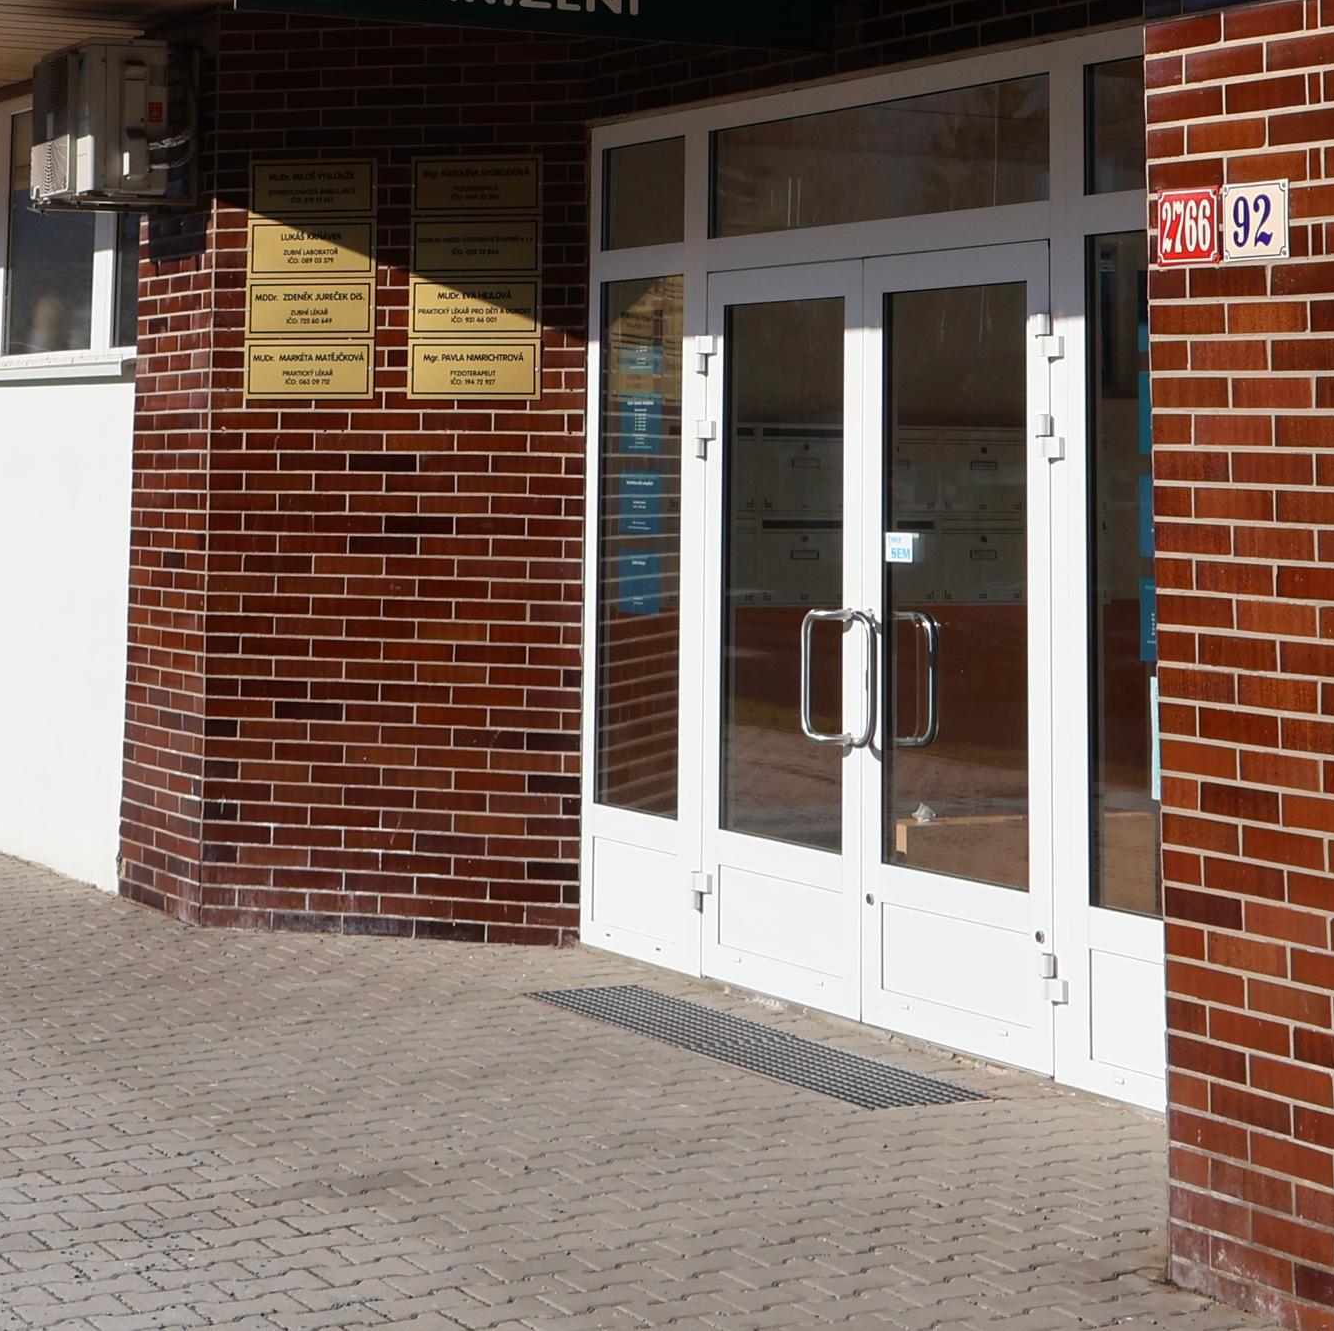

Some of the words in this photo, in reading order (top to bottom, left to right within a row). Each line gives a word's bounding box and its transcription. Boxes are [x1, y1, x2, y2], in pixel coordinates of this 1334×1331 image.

[1233, 194, 1273, 247] 92
[1162, 199, 1211, 253] 2766
[281, 231, 304, 241] LUKÁŠ
[283, 291, 313, 301] ZDENĚK
[315, 291, 348, 301] JUREČEK
[253, 354, 275, 362] MUDr.
[279, 352, 314, 362] MARKÉTA
[315, 352, 364, 361] MATĚJČKOVÁ
[423, 354, 439, 363] Mgr.
[441, 353, 465, 362] PAVLA
[466, 352, 524, 361] NIMRICHTROVÁ
[282, 369, 314, 377] PRAKTICKÝ
